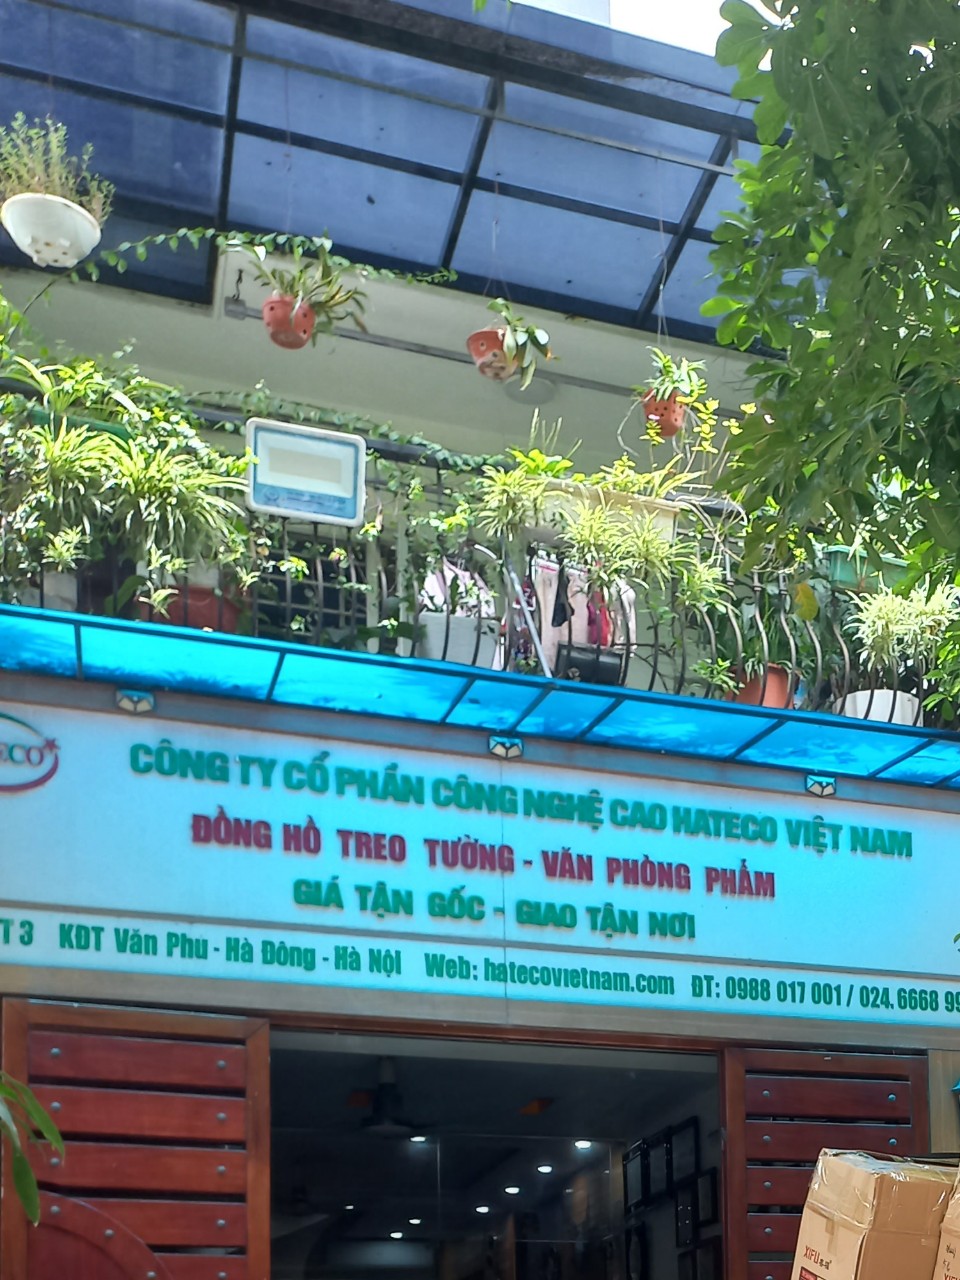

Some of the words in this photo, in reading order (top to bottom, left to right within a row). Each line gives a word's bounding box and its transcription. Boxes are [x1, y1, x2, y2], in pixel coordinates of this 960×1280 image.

[130, 739, 228, 782] CÔNG
[236, 755, 280, 789] TY
[283, 751, 329, 794] CỔ
[336, 763, 424, 806] PHẦN
[432, 775, 518, 816] CÔNG
[524, 789, 603, 831] NGHỆ
[610, 797, 666, 832] CAO
[673, 806, 777, 844] HATECO
[785, 816, 843, 854] VIỆT
[850, 828, 912, 858] NAM
[337, 829, 406, 863] TREO
[424, 834, 514, 873] TƯỜNG
[542, 847, 593, 881] VĂN
[607, 854, 690, 891] PHÒNG
[706, 858, 775, 898] PHẨM
[293, 876, 344, 910] GIÁ
[354, 881, 414, 918] TẬN
[429, 884, 485, 920] GỐC
[516, 899, 577, 929] GIAO
[585, 902, 638, 939] TẬN
[649, 912, 696, 939] NƠI
[114, 928, 158, 956] Văn
[226, 936, 253, 964] Hà
[261, 939, 316, 972] Đông
[334, 944, 361, 972] Hà
[368, 947, 402, 977] Nội
[424, 952, 478, 981] Web:
[483, 957, 674, 997] hatecovietnam.com
[726, 977, 770, 1001] 0988
[777, 979, 807, 1004] 017
[811, 982, 842, 1007] 001
